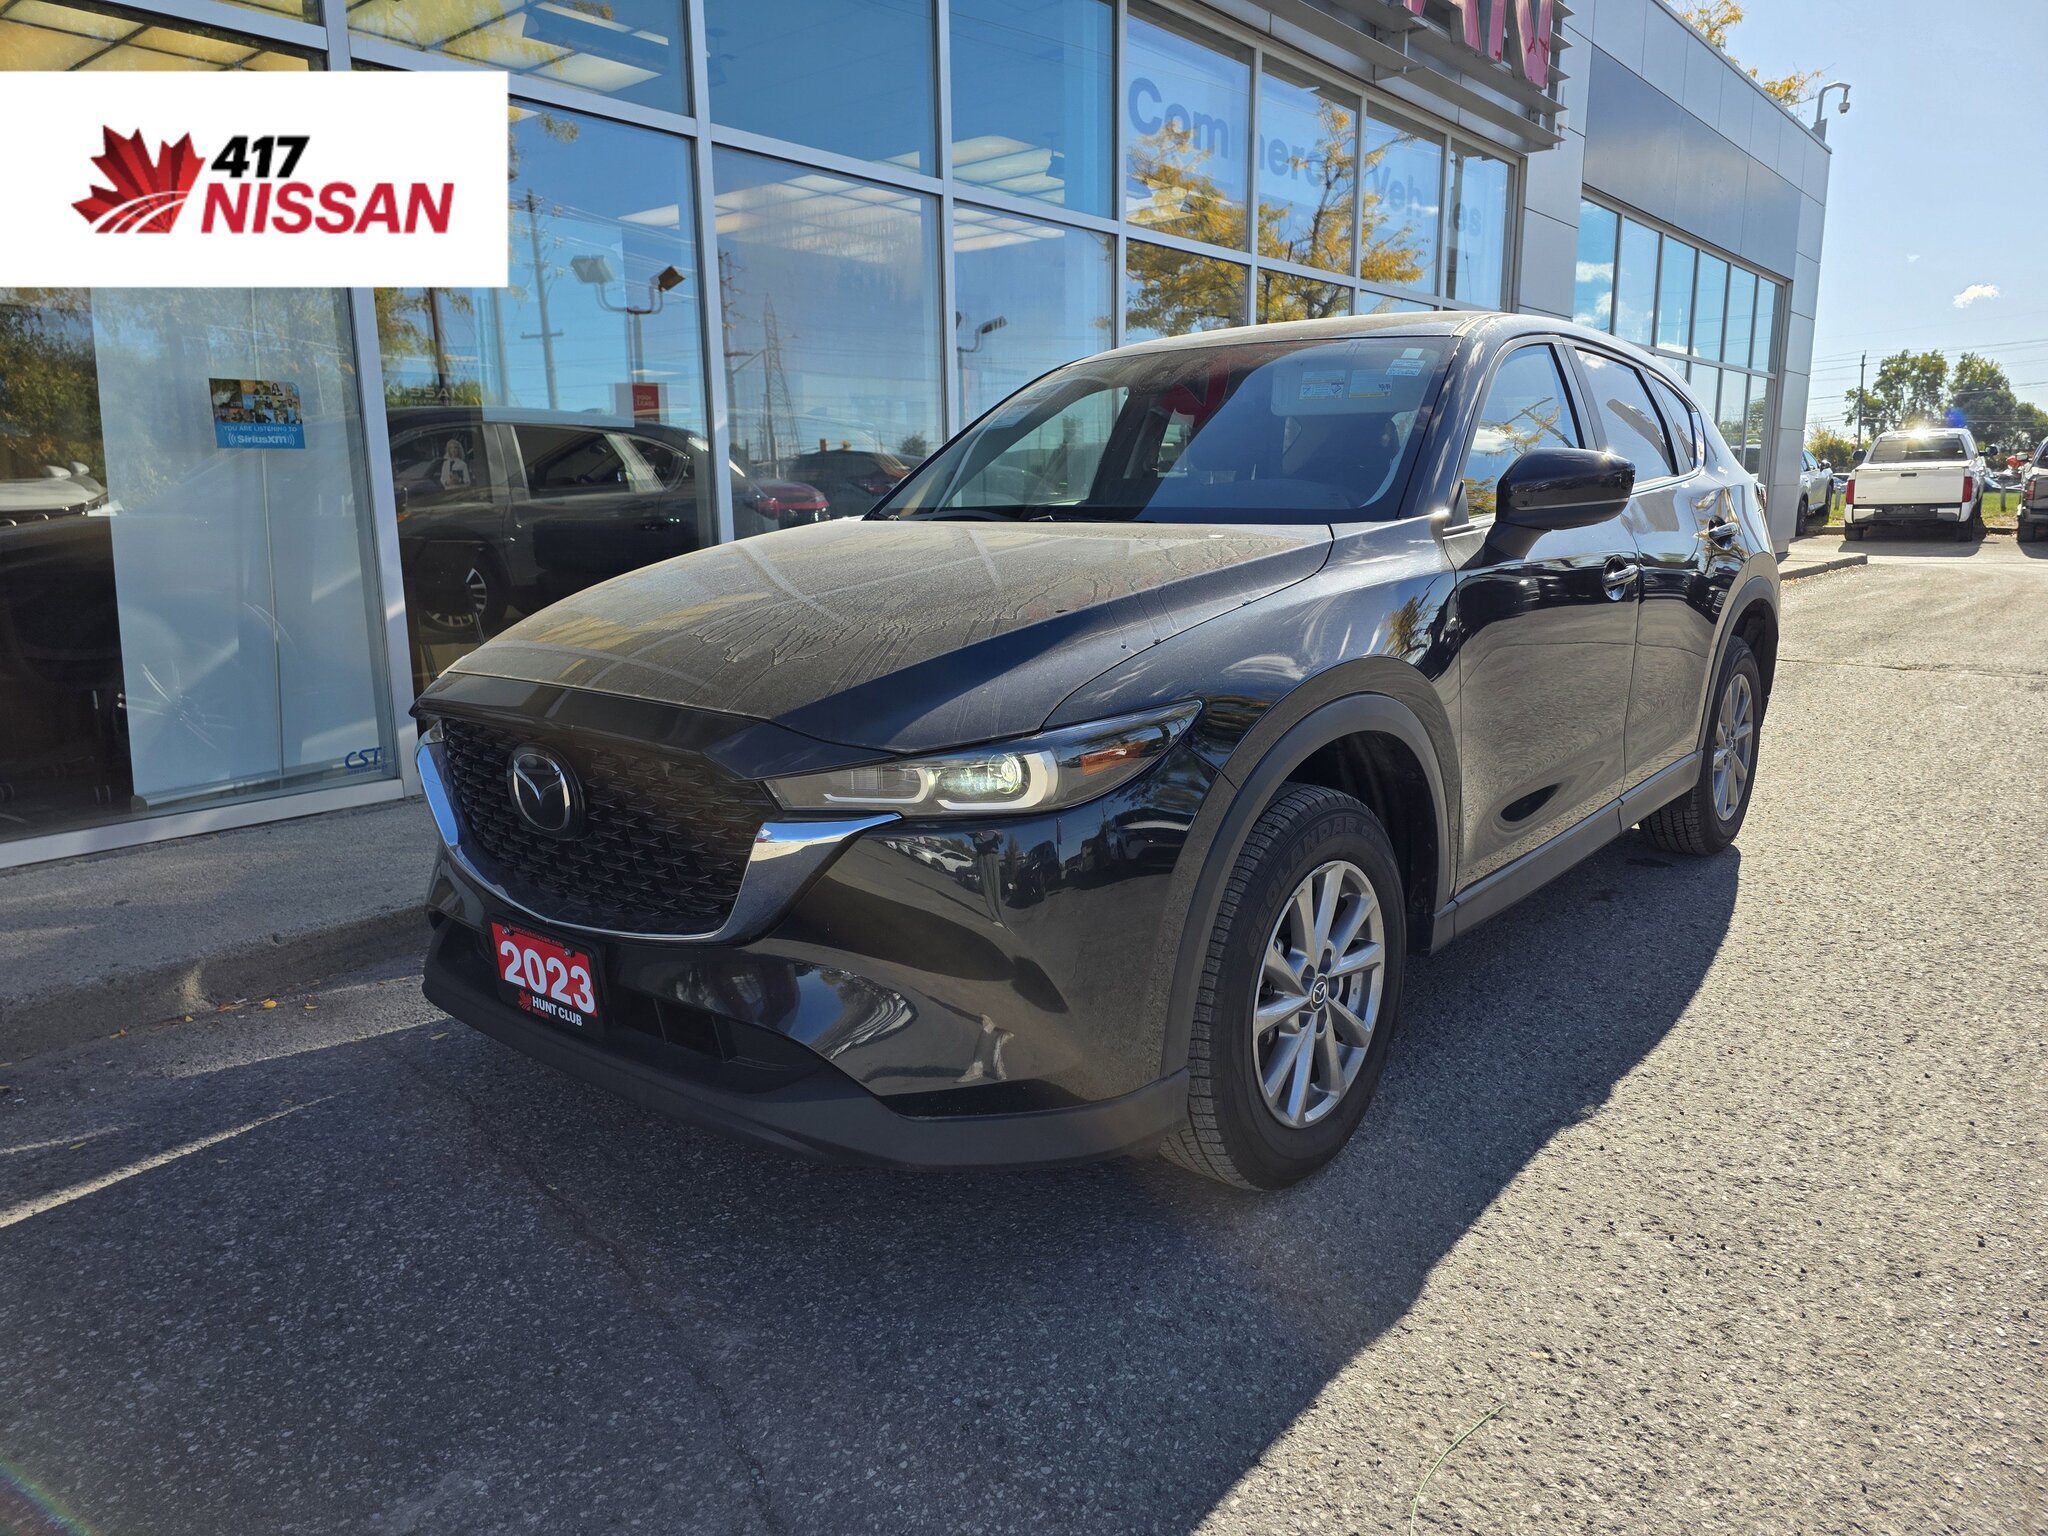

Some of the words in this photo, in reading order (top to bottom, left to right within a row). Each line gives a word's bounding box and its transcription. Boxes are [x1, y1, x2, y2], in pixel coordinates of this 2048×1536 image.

[1247, 816, 1359, 958] GEOLANDAR
[500, 940, 595, 1013] 2023
[532, 996, 557, 1015] HUNT
[558, 1006, 582, 1026] CLUB
